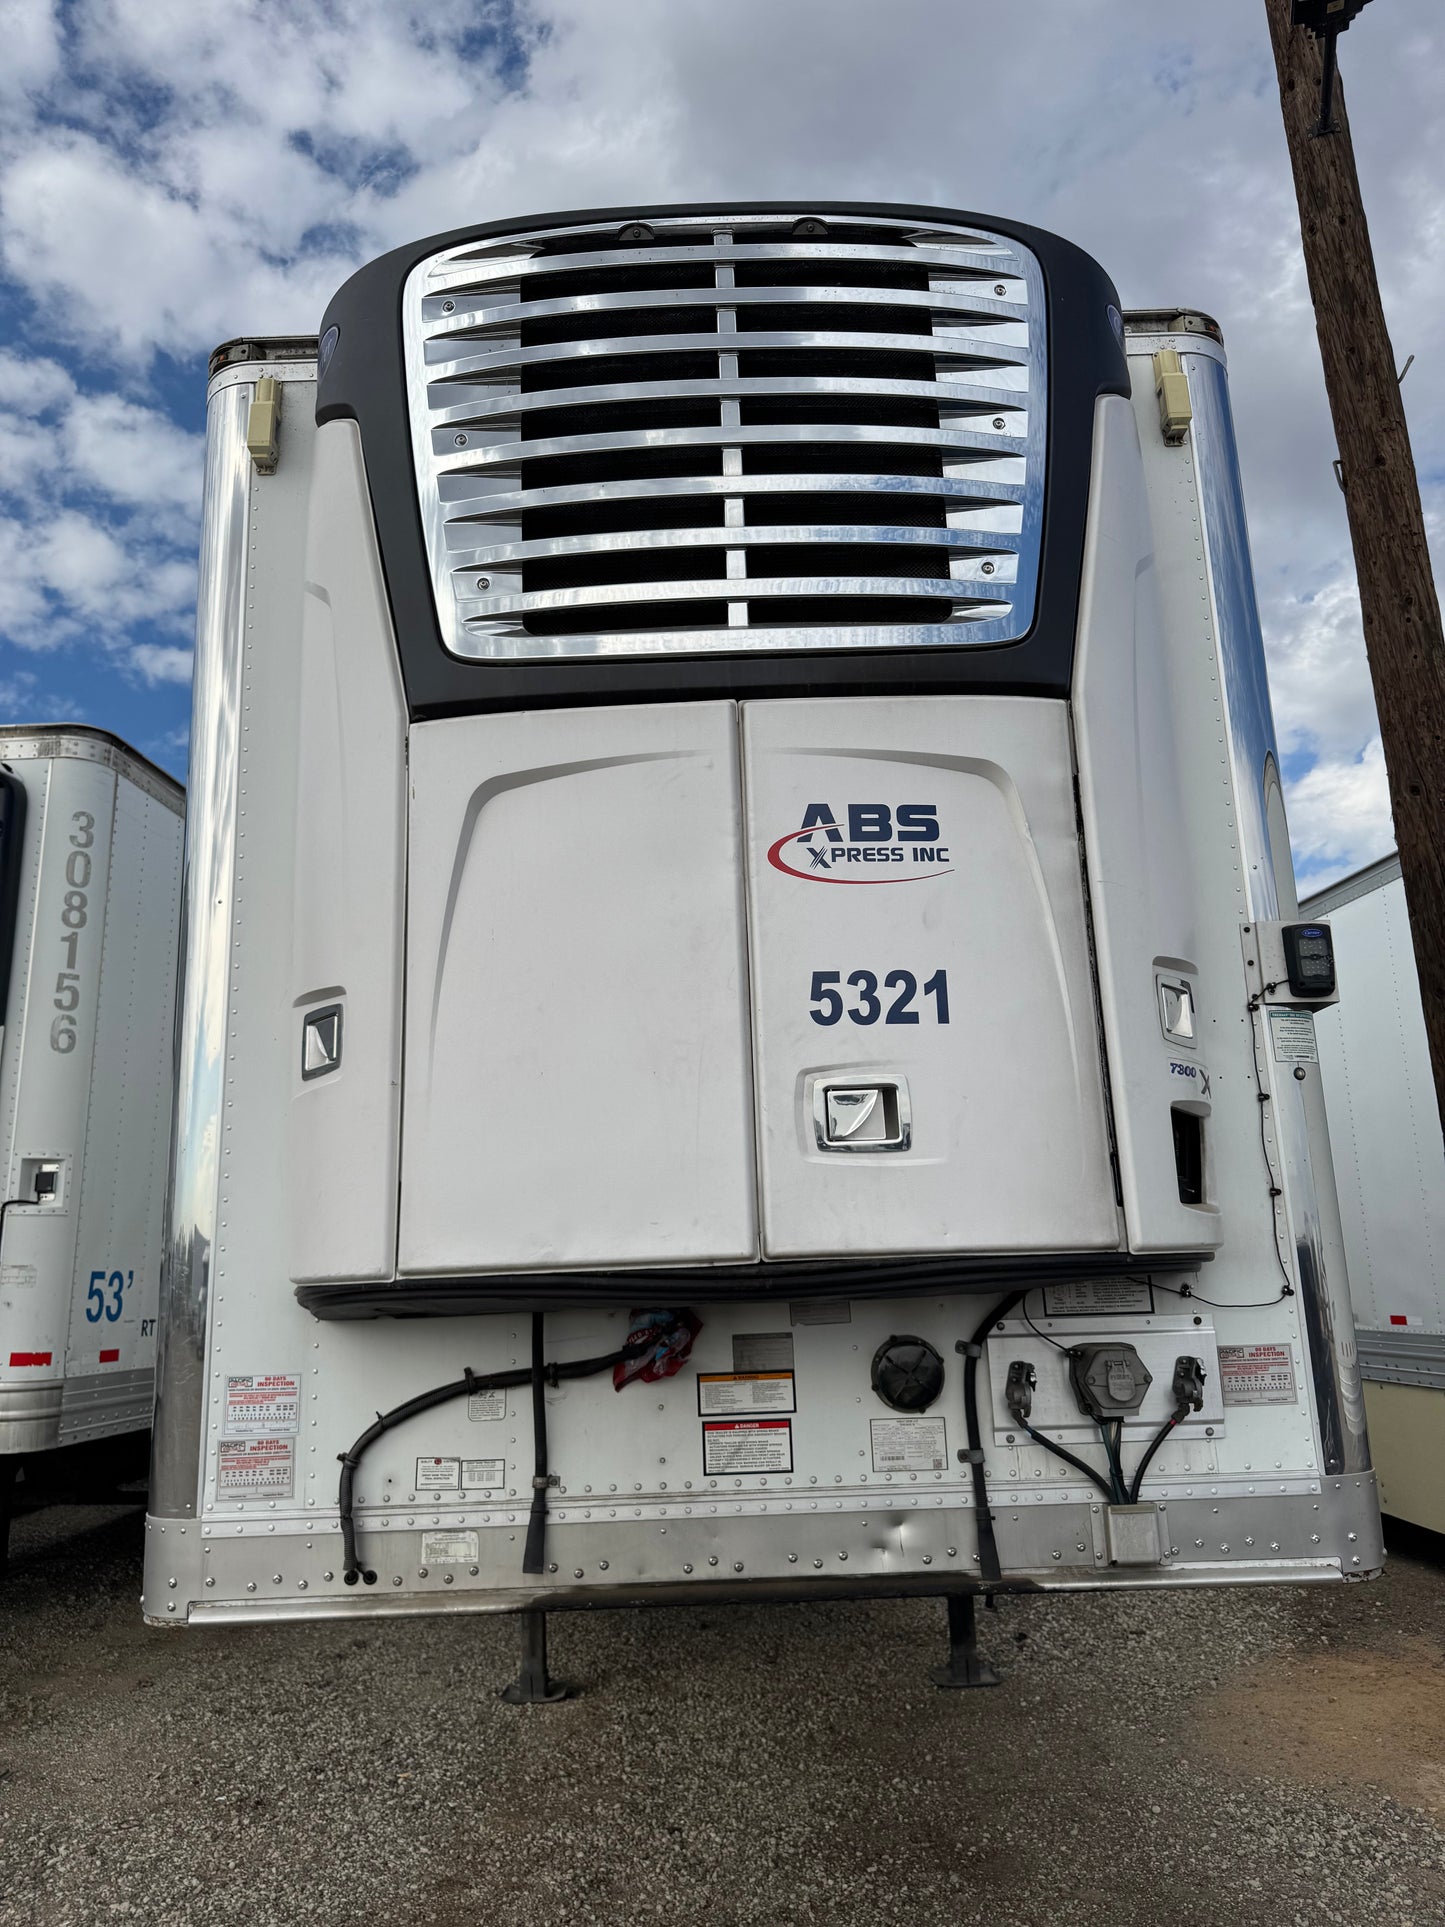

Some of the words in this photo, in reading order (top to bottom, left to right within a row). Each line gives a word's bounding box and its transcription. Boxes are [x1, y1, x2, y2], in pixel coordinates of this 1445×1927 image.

[797, 803, 940, 842] ABS
[806, 846, 904, 869] XPRESS
[912, 847, 950, 862] INC
[50, 811, 95, 1054] 308156
[809, 969, 950, 1026] 5321
[1170, 1062, 1197, 1078] 7300
[141, 1319, 156, 1337] RT
